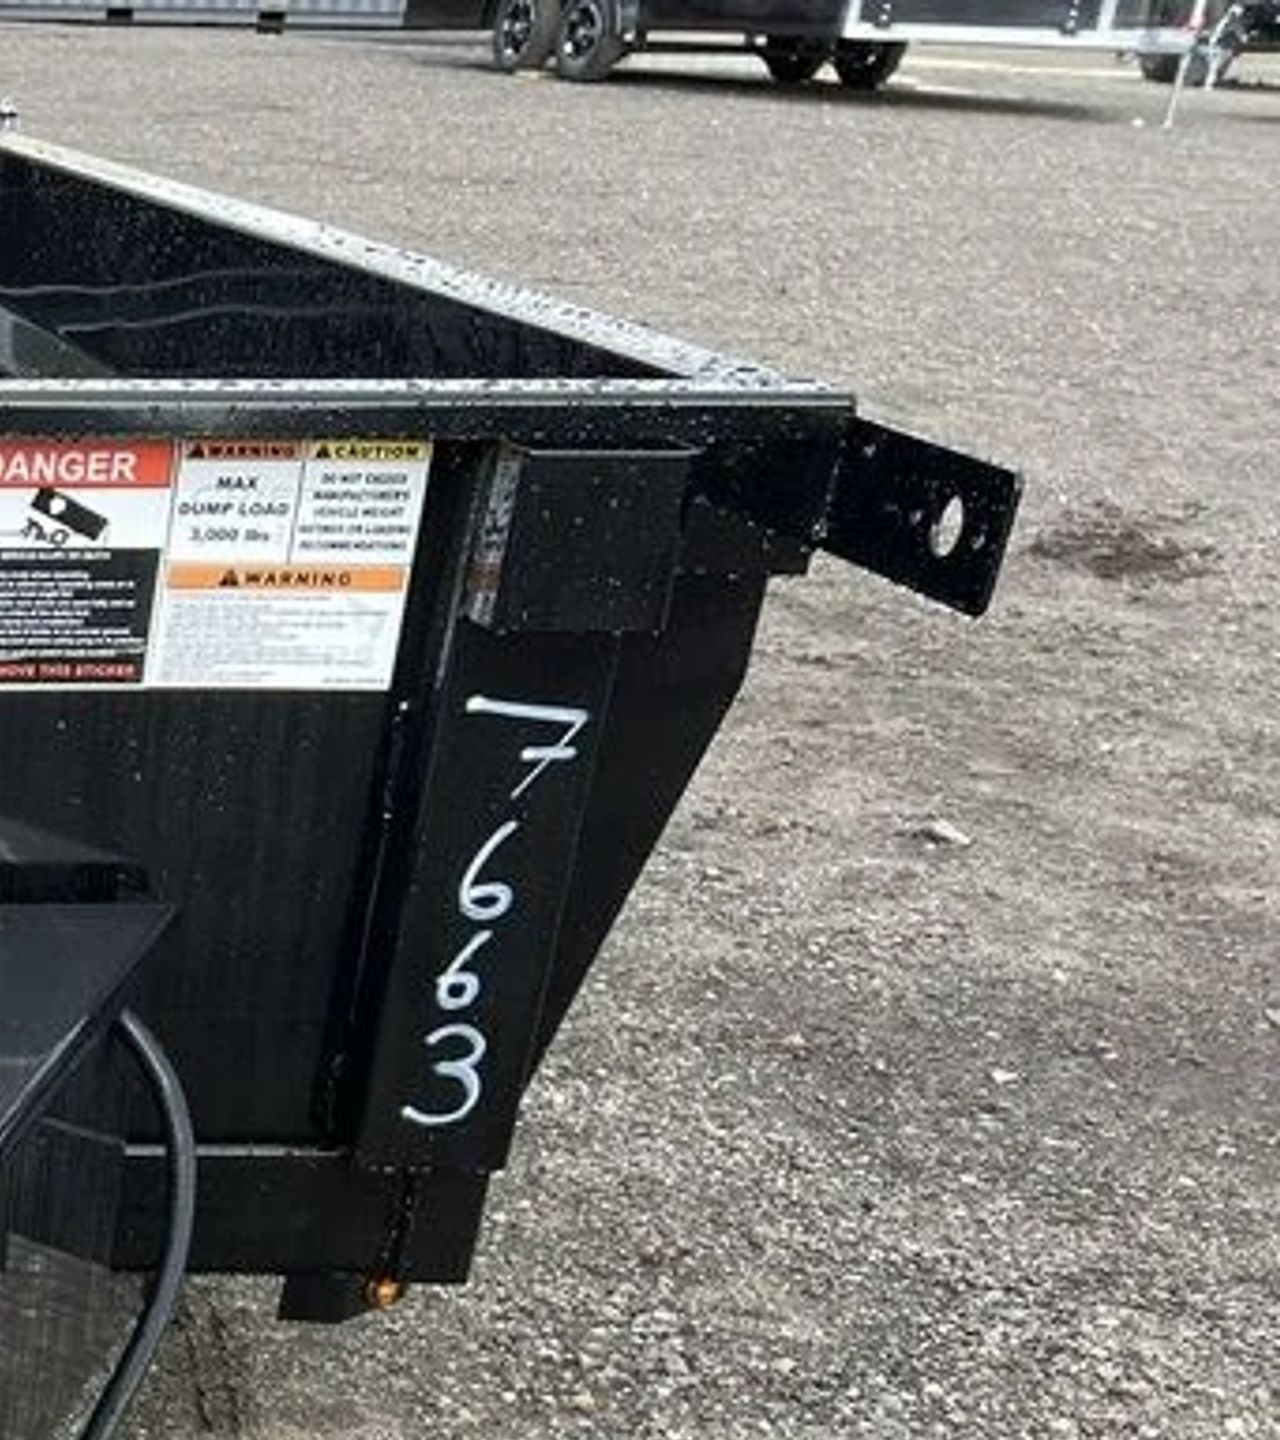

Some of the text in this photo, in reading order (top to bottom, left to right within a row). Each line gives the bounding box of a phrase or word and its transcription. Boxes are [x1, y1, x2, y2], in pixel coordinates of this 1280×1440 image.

[208, 445, 295, 457] WARNING
[335, 446, 419, 458] CAUTION
[217, 477, 258, 490] MAX
[178, 502, 290, 516] DUMP LOAD
[190, 529, 238, 542] 3,000
[244, 572, 352, 586] WARNING
